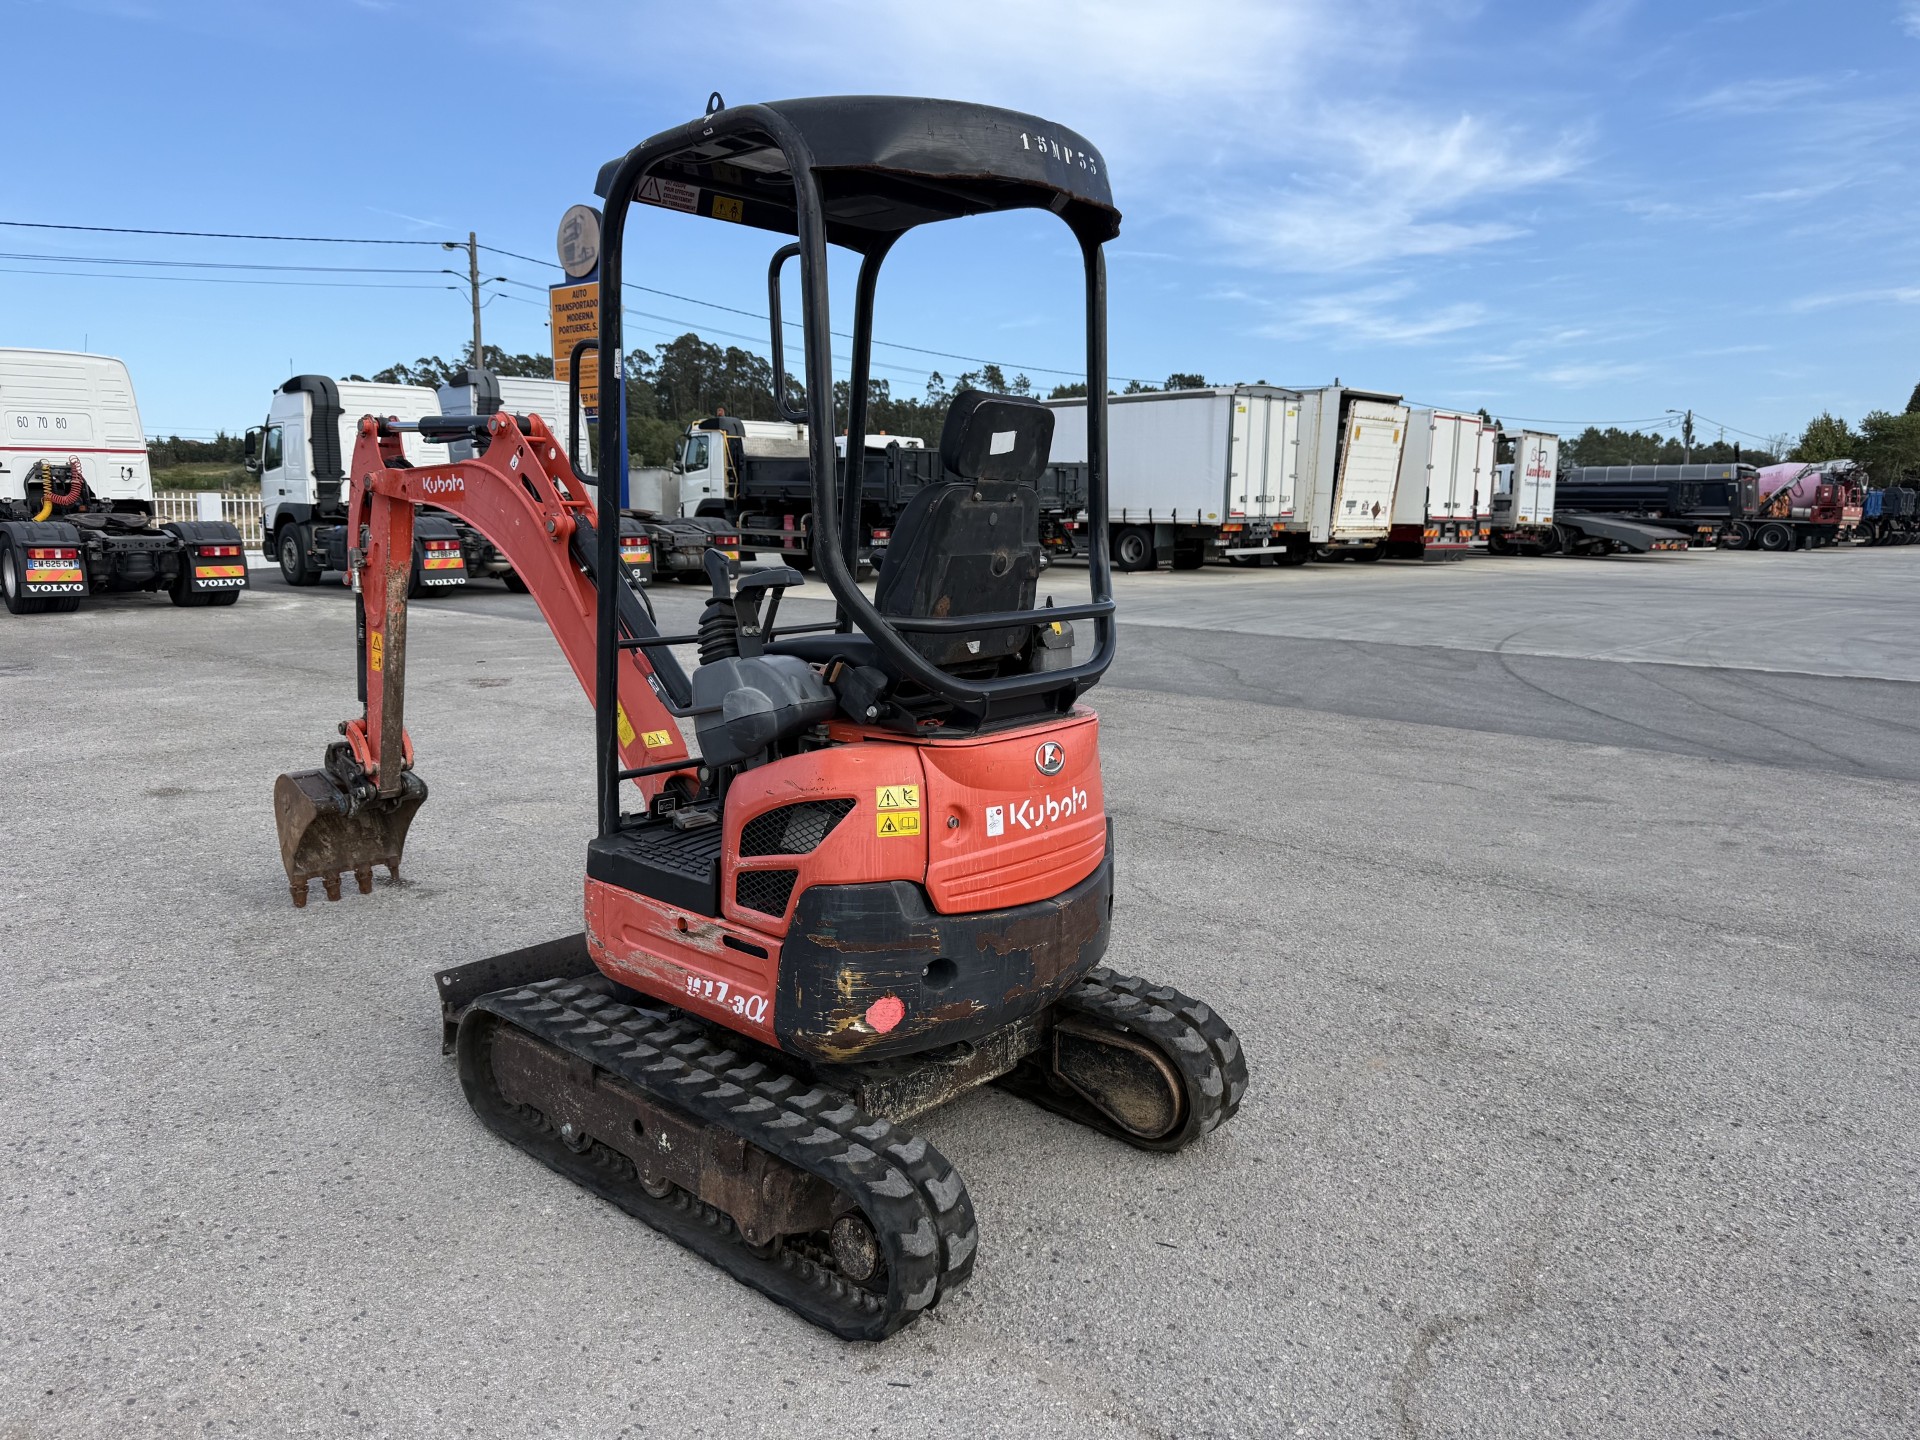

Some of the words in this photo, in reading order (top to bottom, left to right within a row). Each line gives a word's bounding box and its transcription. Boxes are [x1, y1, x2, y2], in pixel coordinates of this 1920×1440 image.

[572, 288, 587, 299] AUTO
[555, 298, 599, 313] TRANSPORTADO
[566, 310, 594, 323] MODERNA
[558, 322, 592, 335] PORTUENSE,
[16, 415, 29, 428] 60
[37, 416, 48, 429] 70
[55, 416, 67, 430] 80
[422, 473, 465, 494] Kubota
[26, 583, 84, 593] VOLVO
[196, 577, 246, 588] VOLVO
[424, 577, 466, 586] VOLVO
[1009, 786, 1088, 830] Kubota
